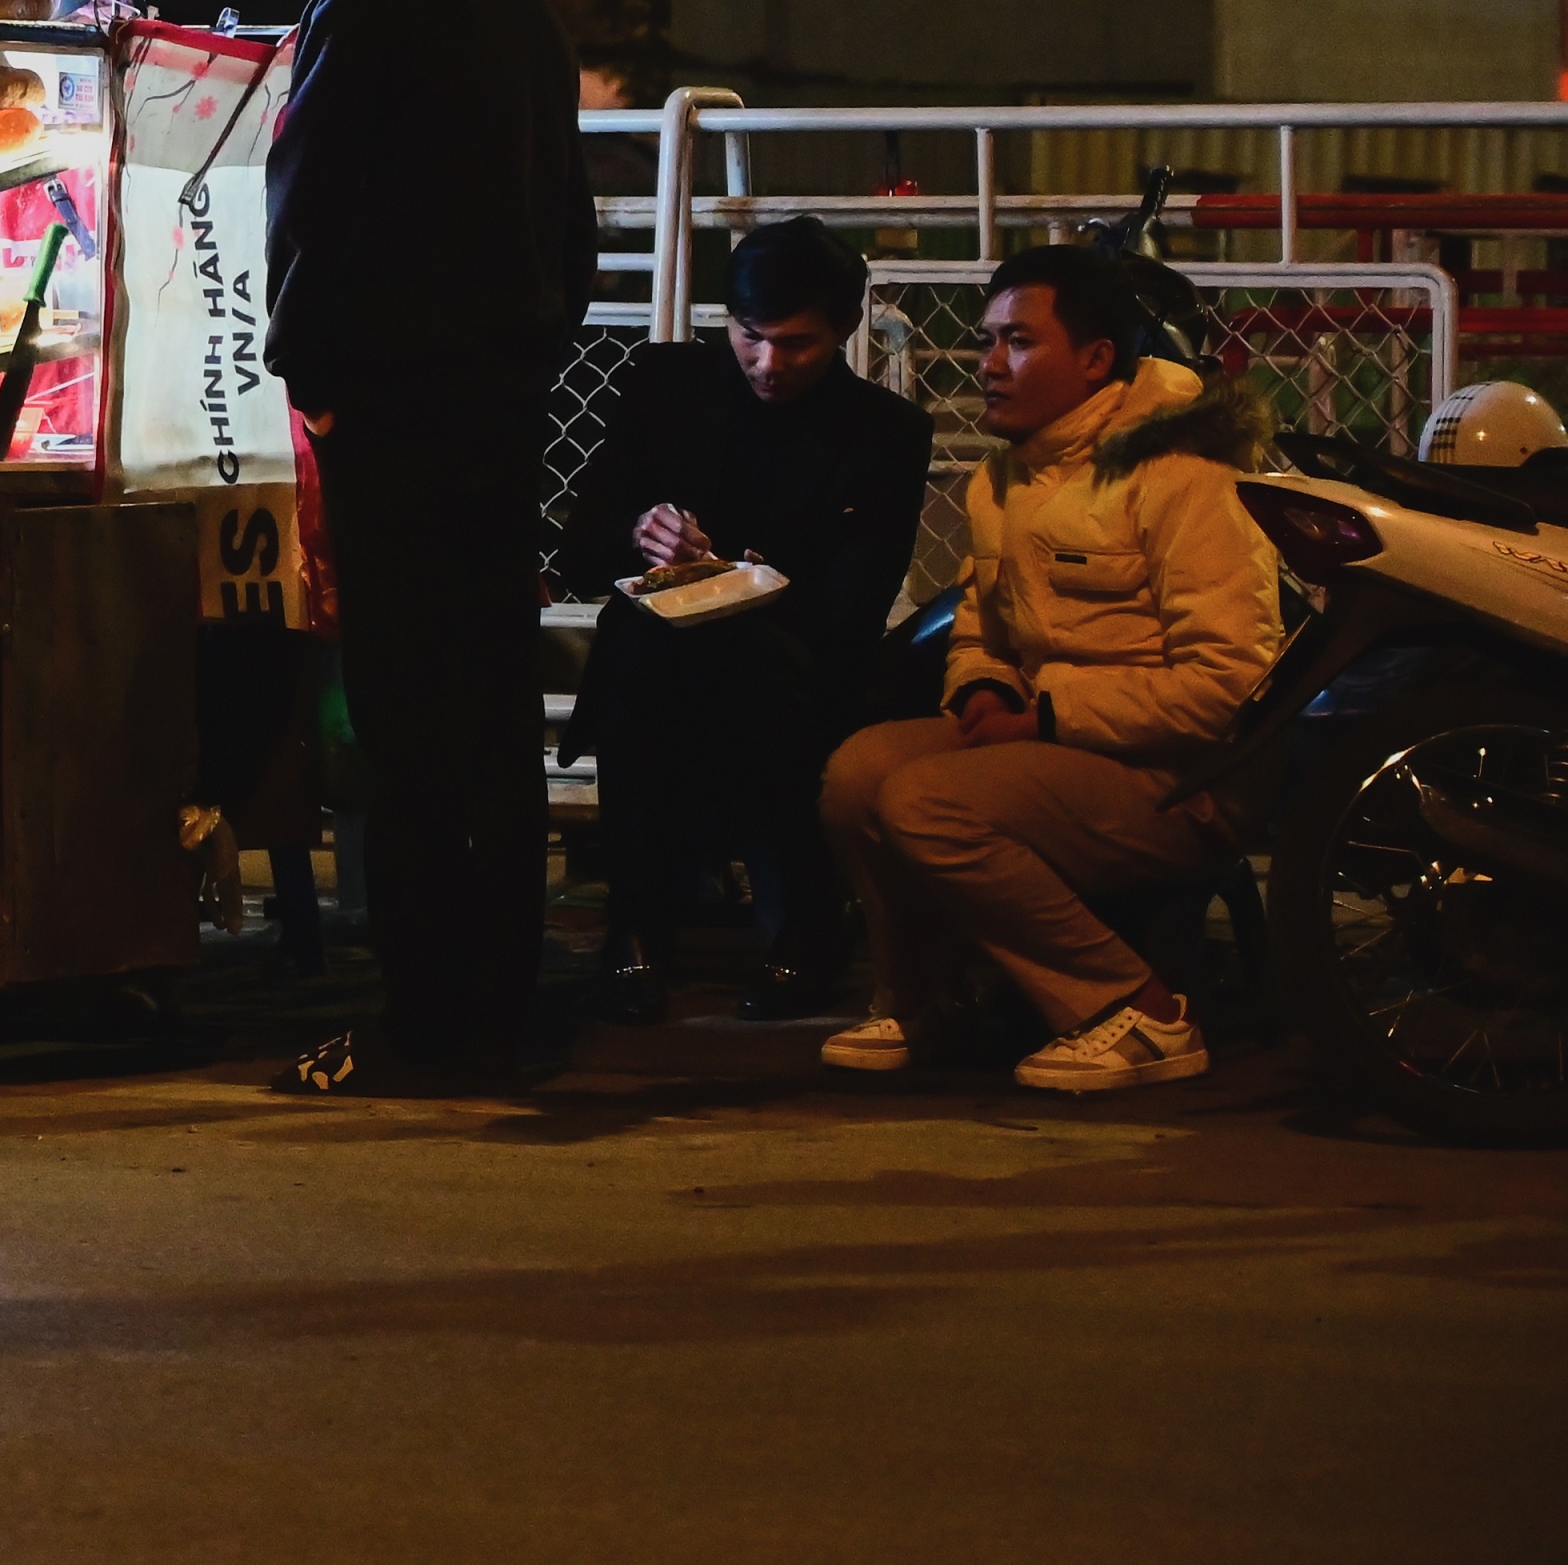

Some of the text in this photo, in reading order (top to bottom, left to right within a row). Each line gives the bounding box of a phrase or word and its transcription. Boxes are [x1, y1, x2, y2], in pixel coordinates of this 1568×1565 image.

[189, 182, 239, 486] CHÍNH HÃNG
[231, 269, 261, 396] VN/A
